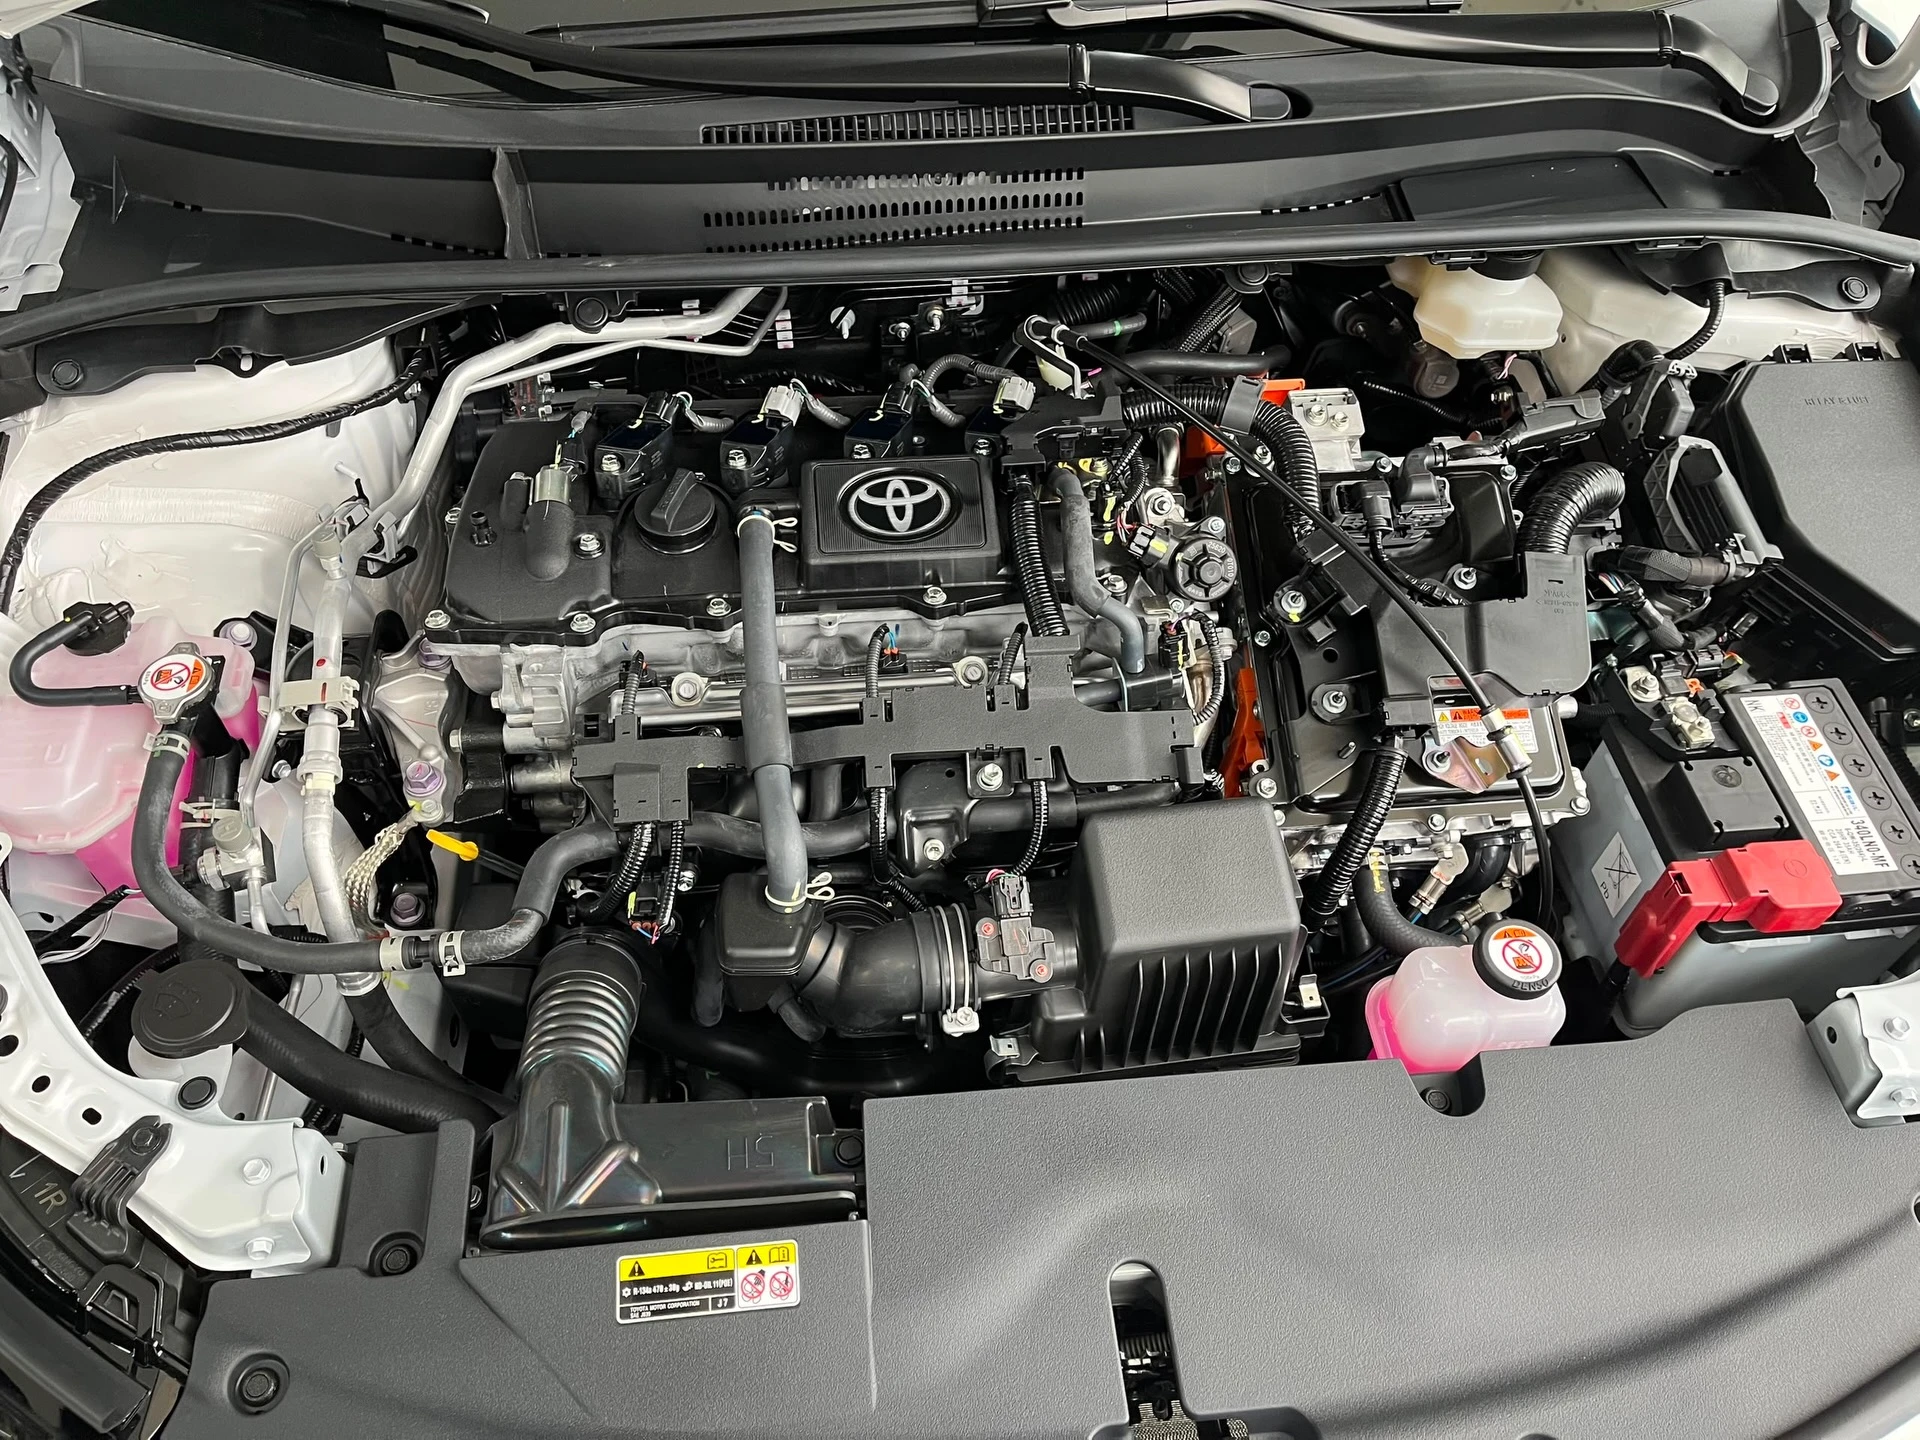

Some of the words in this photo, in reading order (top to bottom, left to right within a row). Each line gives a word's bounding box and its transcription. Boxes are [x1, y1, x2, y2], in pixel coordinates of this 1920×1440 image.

[1745, 699, 1765, 713] NK
[1600, 882, 1610, 899] Pb
[1511, 979, 1549, 991] DENSO
[34, 1182, 68, 1215] 1R
[667, 1300, 700, 1309] CORPORATION
